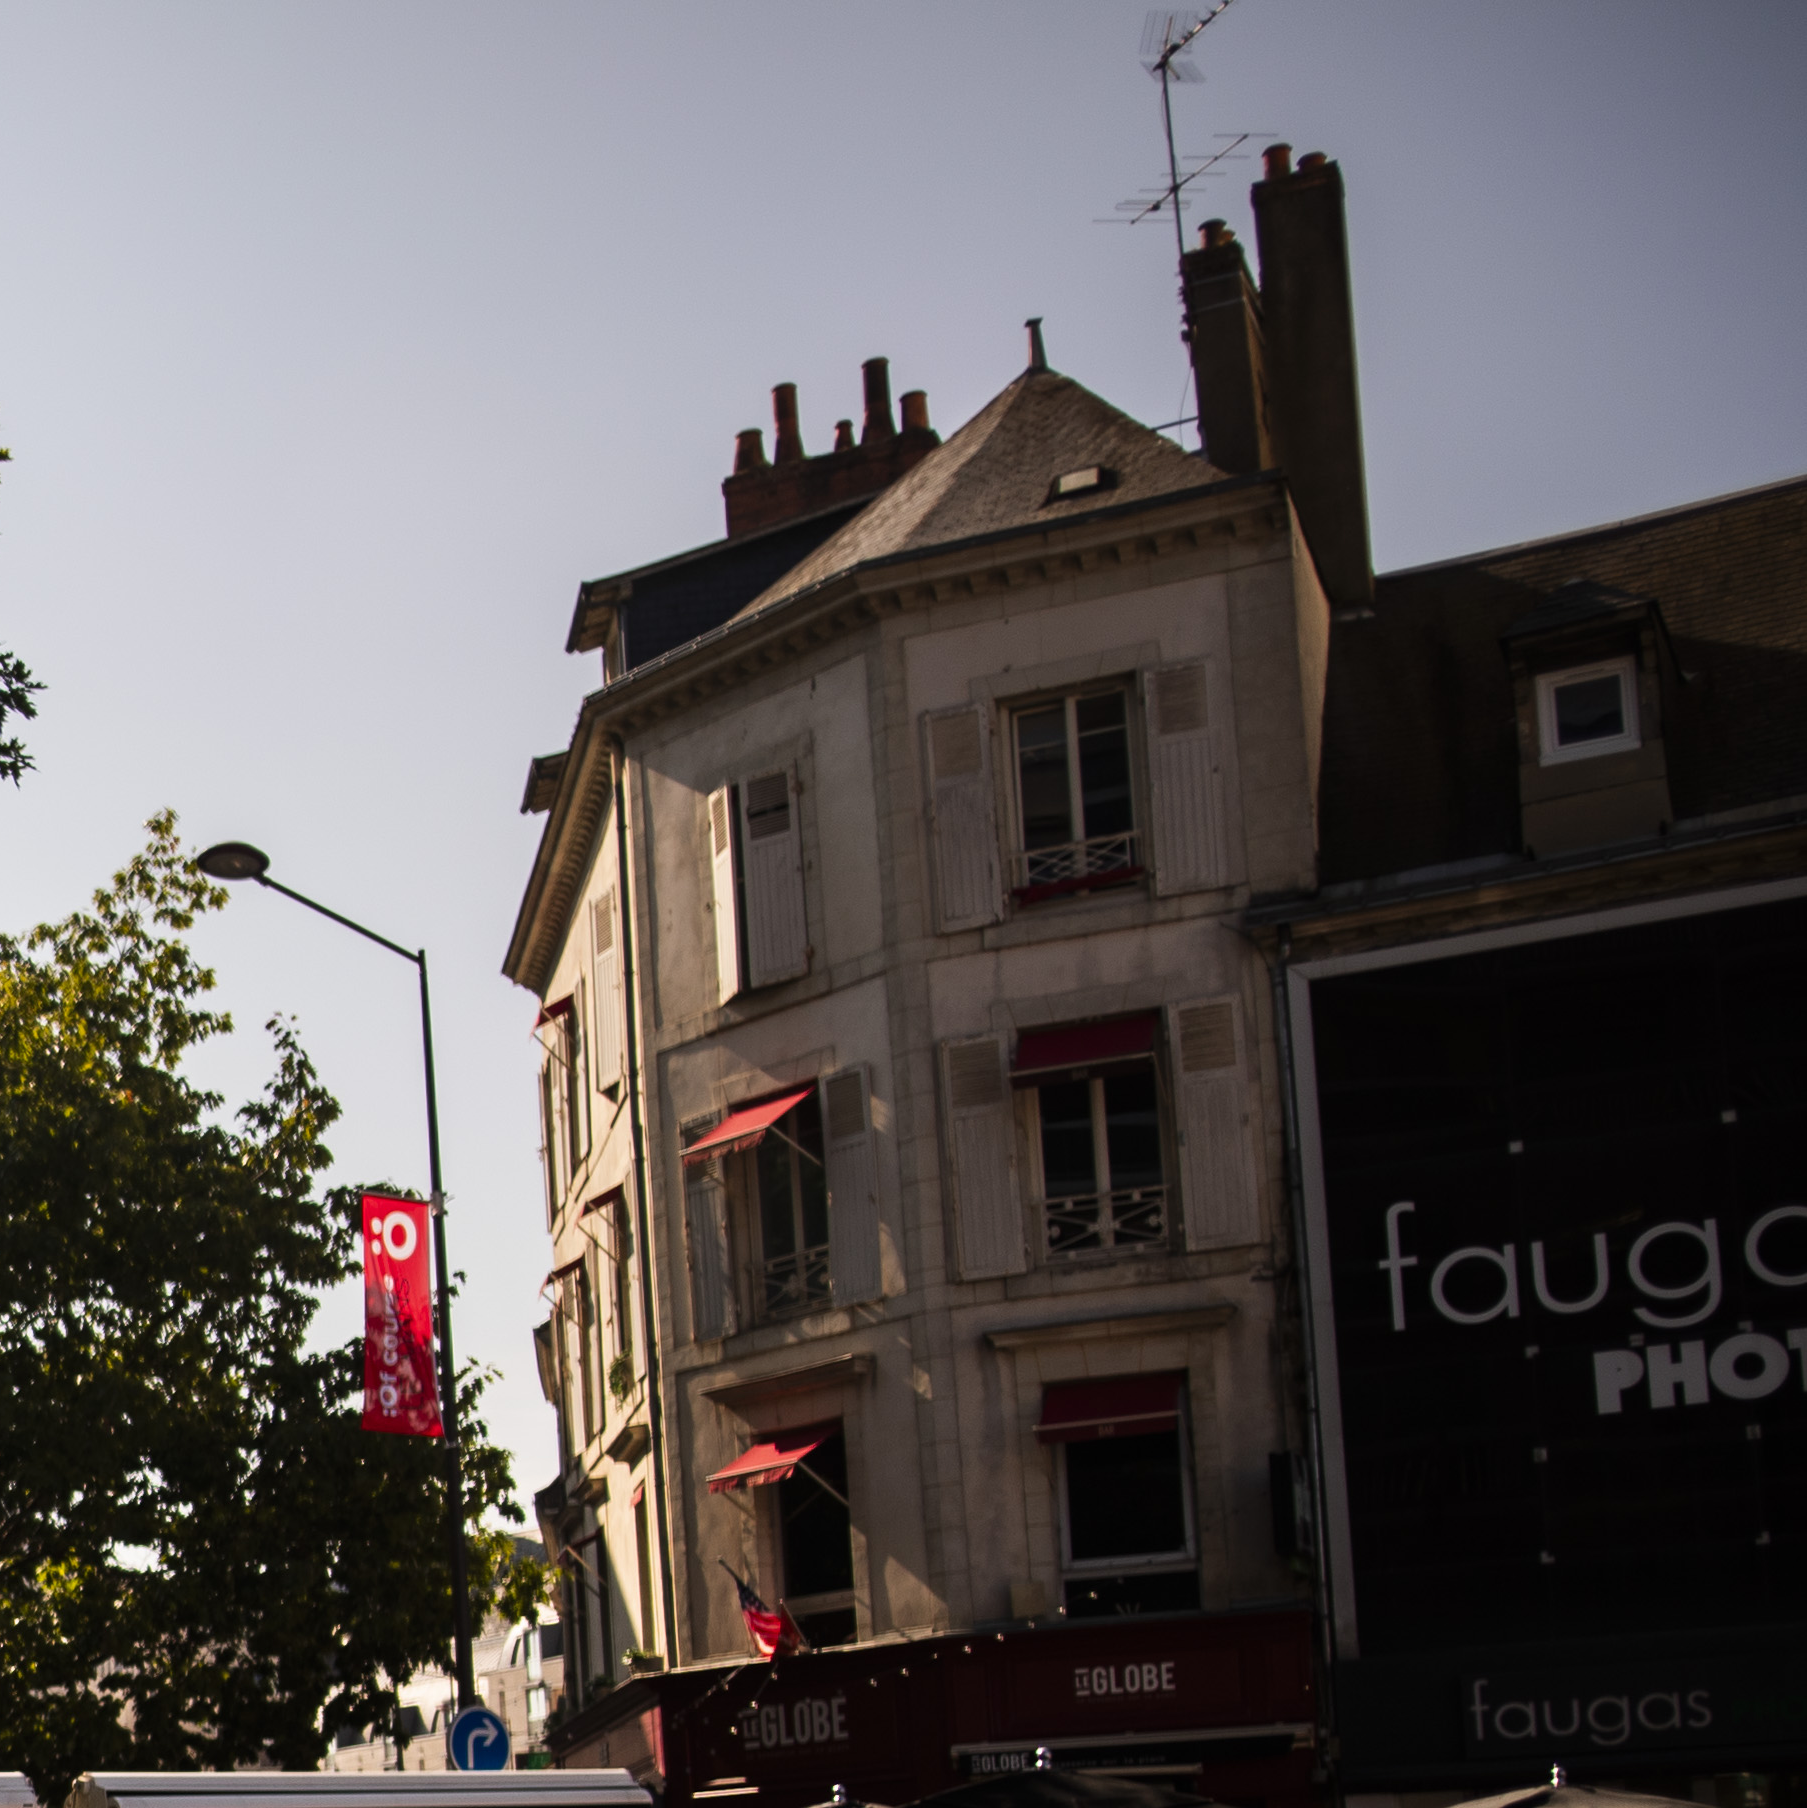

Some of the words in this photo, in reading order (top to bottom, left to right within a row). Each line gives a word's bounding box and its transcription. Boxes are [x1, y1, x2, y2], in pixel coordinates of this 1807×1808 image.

[1091, 1661, 1177, 1696] GLOBE
[760, 1697, 849, 1749] GLOBE
[1470, 1678, 1713, 1746] faugas
[982, 1752, 1030, 1774] GLOBE
